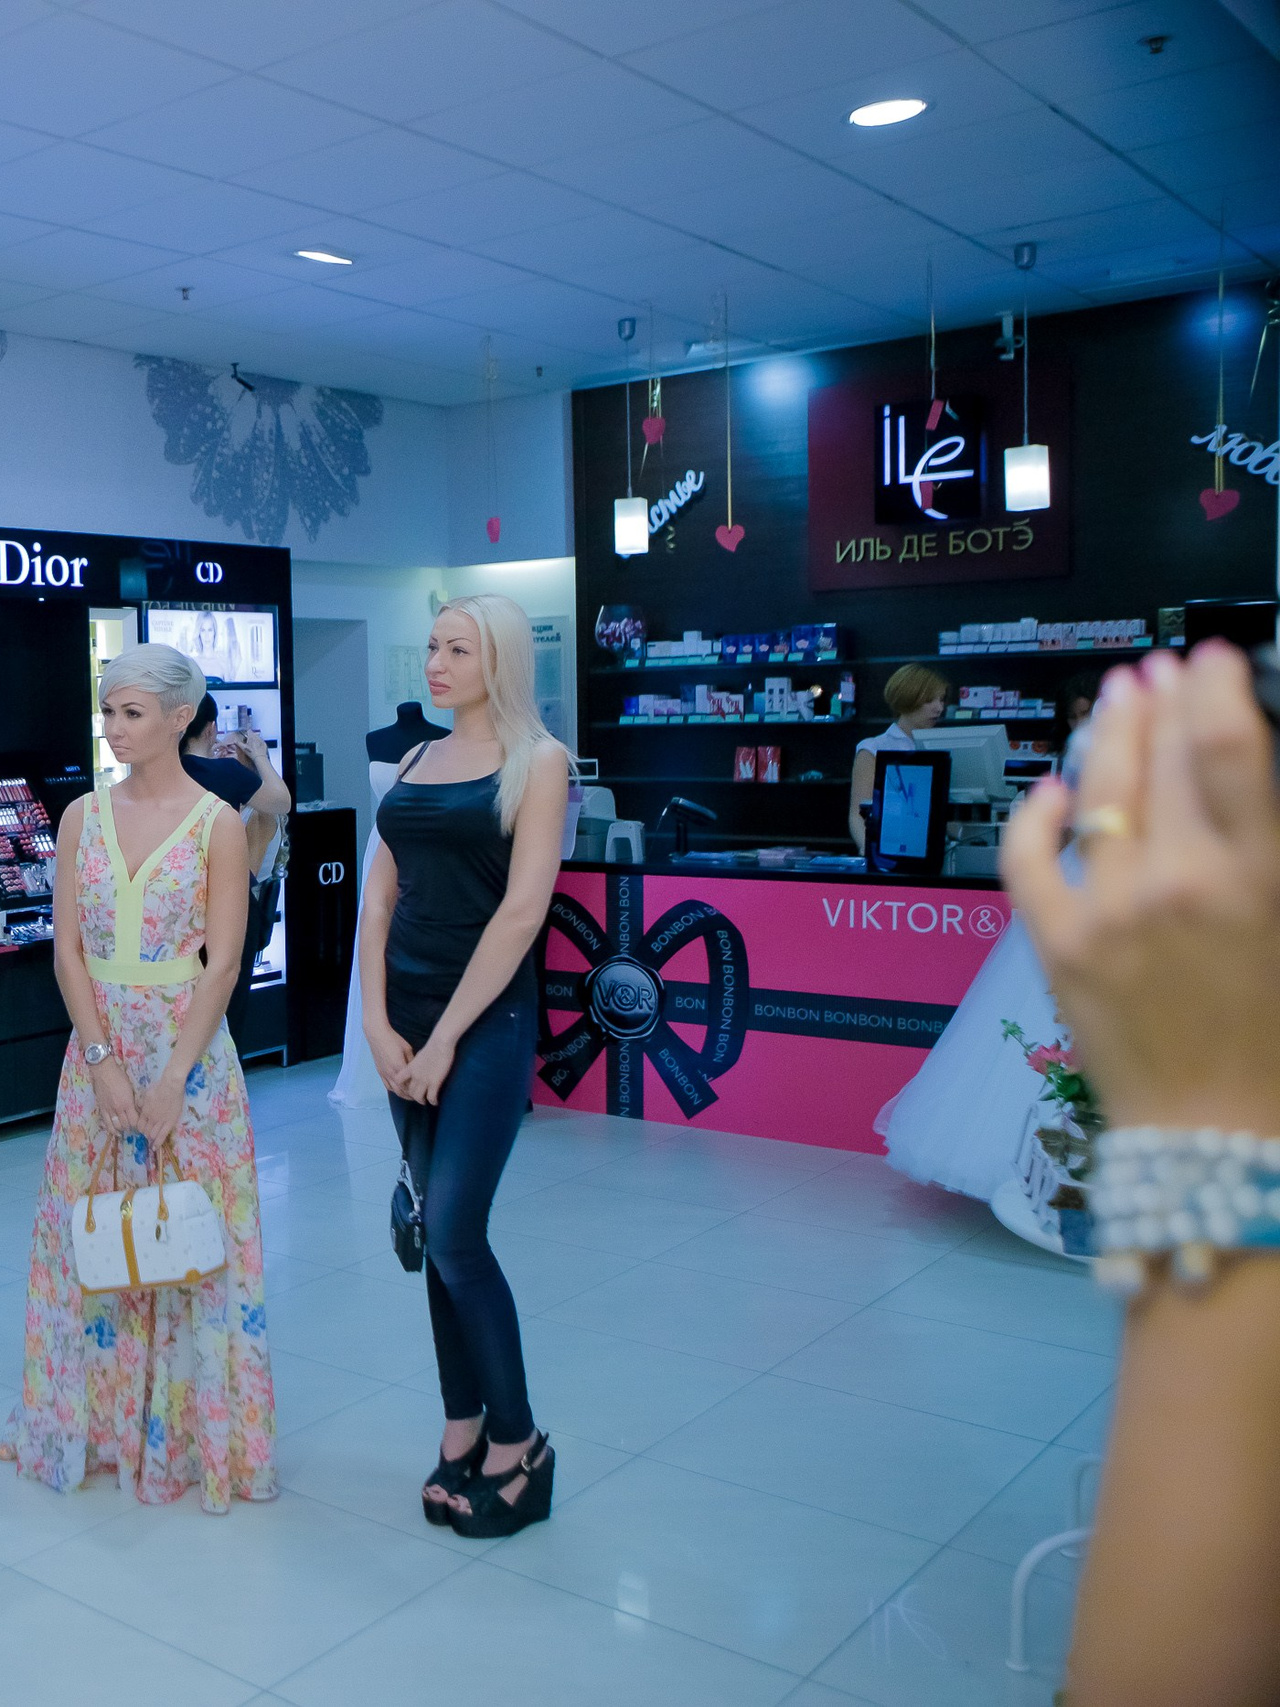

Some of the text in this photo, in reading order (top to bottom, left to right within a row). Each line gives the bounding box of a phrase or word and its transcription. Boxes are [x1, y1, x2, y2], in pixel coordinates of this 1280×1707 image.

[836, 537, 892, 564] ИЛЬ
[899, 533, 938, 563] ДЕ
[195, 561, 224, 583] CD
[318, 861, 345, 885] CD
[619, 877, 630, 907] BON
[552, 903, 601, 951] BONBON
[650, 910, 705, 953] BONBON
[545, 983, 573, 997] BON
[675, 996, 706, 1011] BON
[713, 930, 735, 1063] BON BONBON BON
[754, 1003, 820, 1022] BONBON
[824, 1010, 894, 1029] BONBON
[542, 1031, 592, 1063] BONBON
[658, 1048, 703, 1106] BONBON
